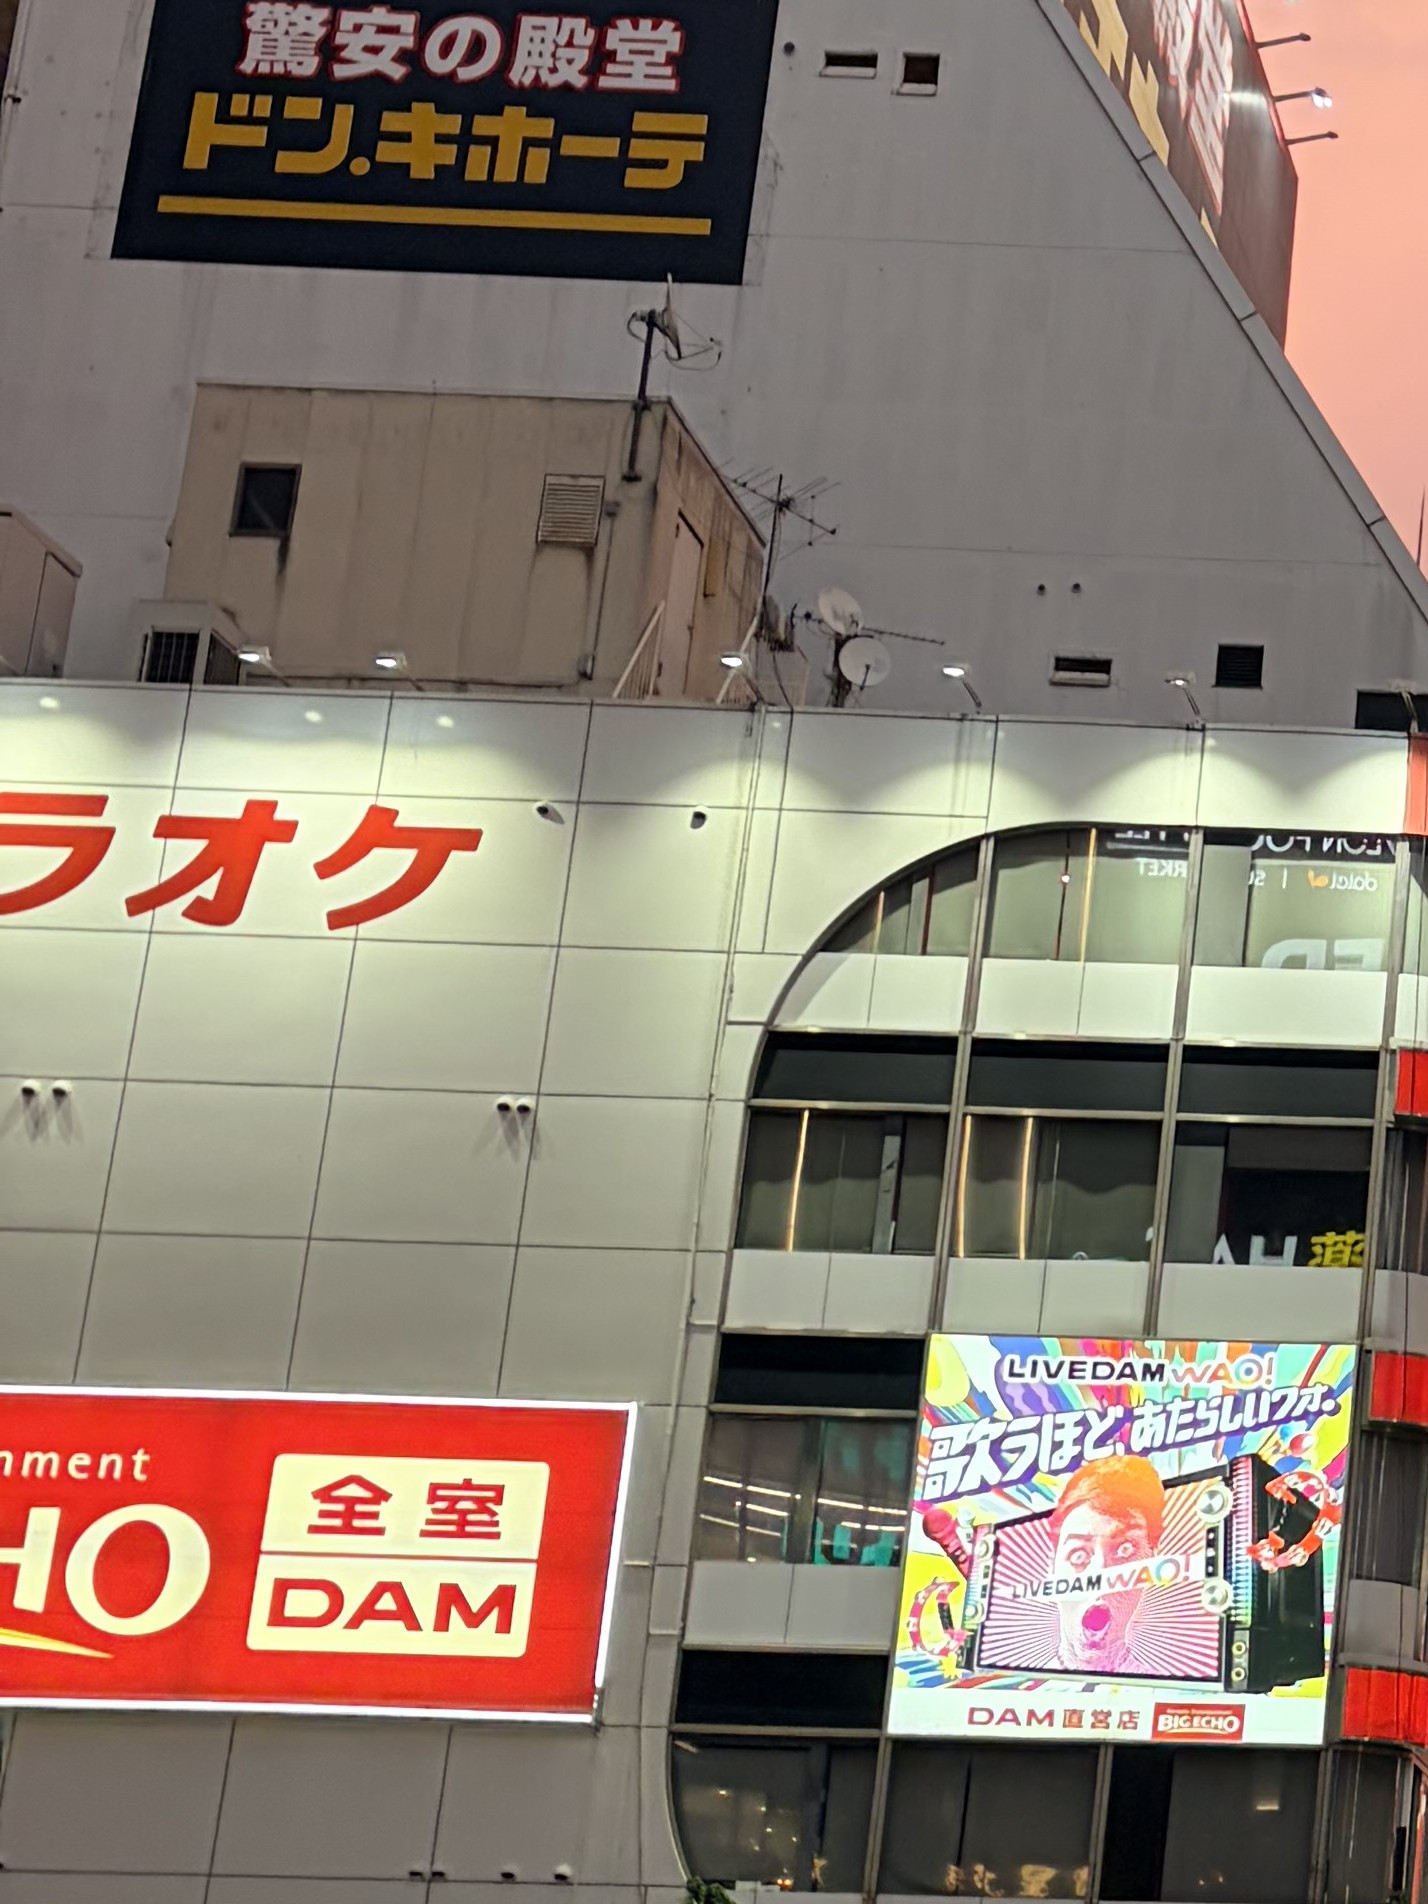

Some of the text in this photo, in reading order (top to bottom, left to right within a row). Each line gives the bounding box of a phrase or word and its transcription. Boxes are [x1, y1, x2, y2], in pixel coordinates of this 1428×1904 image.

[0, 792, 483, 930] ラオケ
[1007, 1357, 1276, 1385] LIVEDAM WAO!
[308, 1474, 506, 1541] 全室
[266, 1577, 518, 1635] DAM
[1011, 1573, 1102, 1599] LIVEDAM
